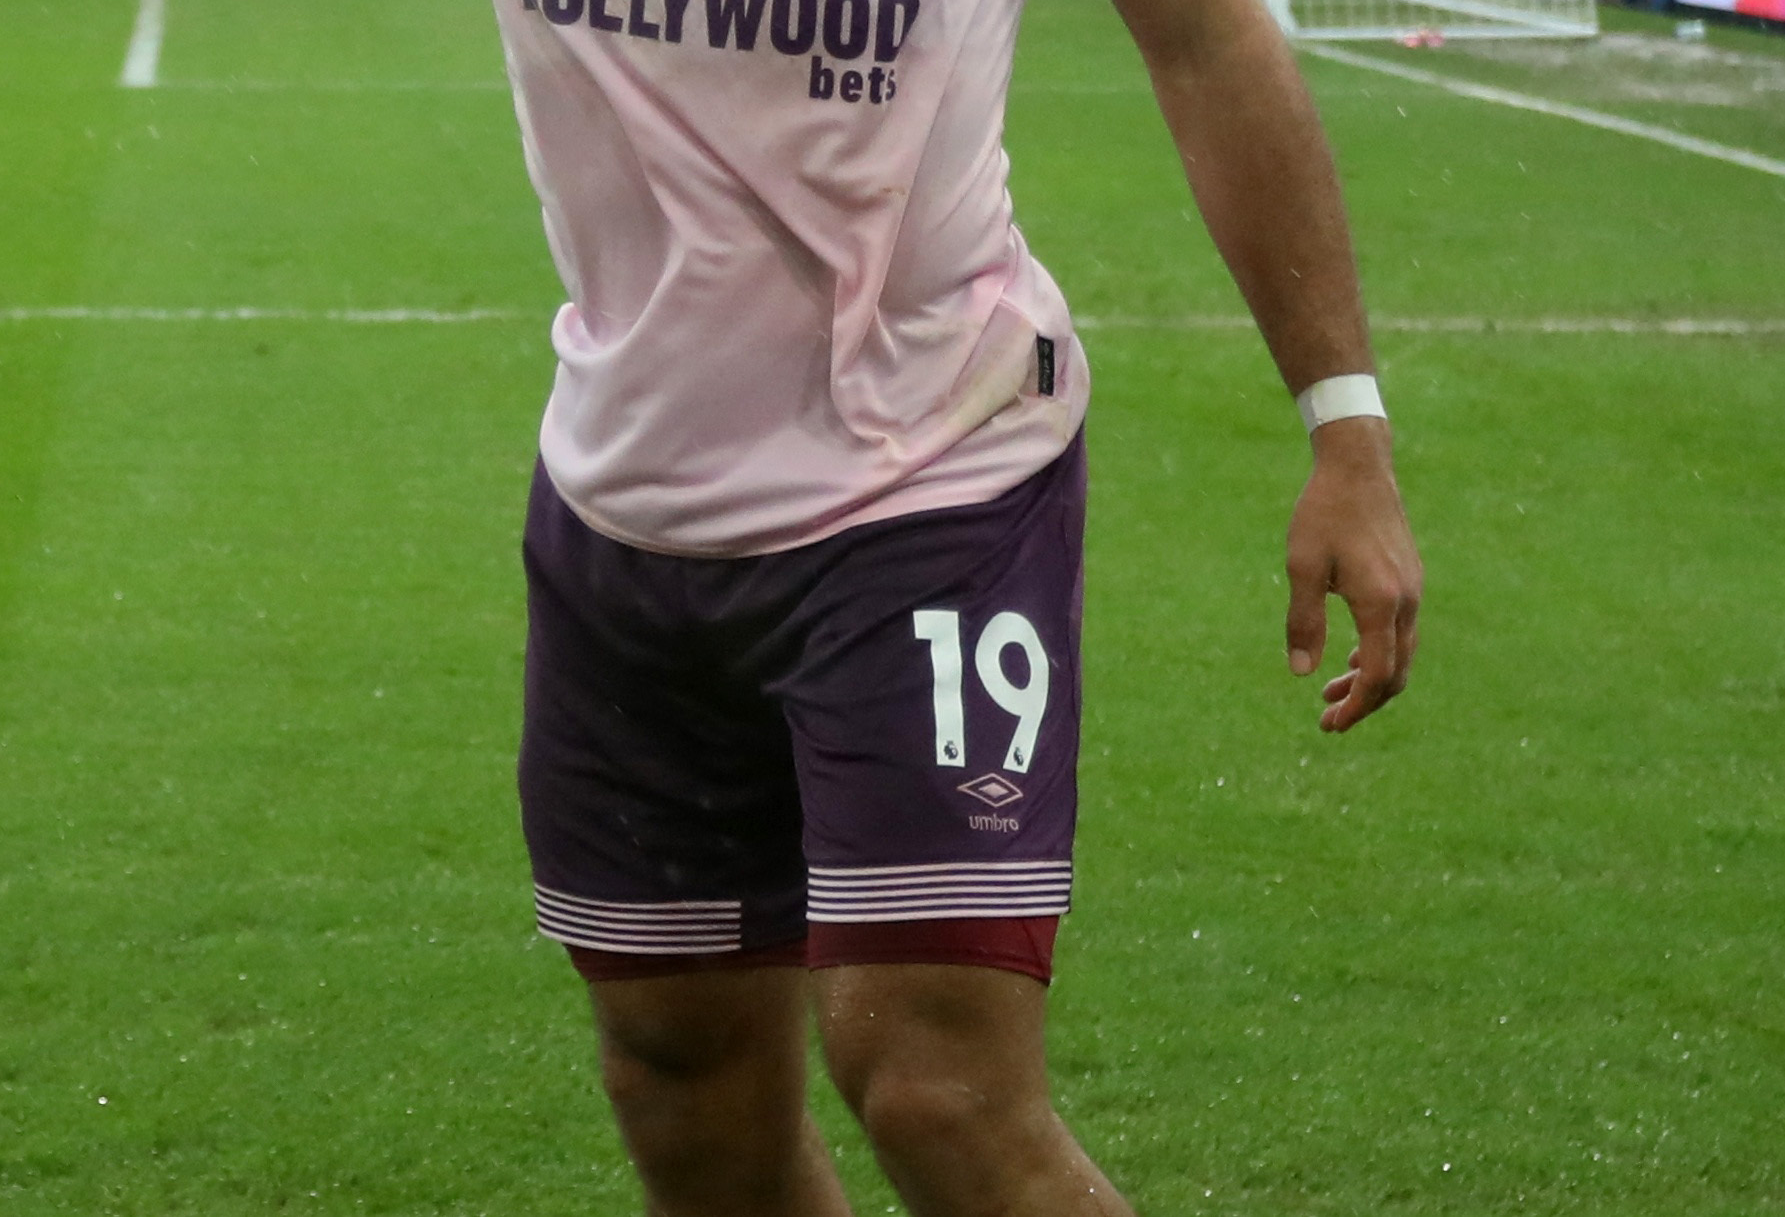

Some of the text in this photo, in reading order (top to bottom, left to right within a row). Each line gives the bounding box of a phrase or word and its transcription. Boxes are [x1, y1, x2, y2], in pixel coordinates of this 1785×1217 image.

[809, 55, 897, 105] bets
[913, 610, 1049, 774] 19
[968, 814, 1020, 833] umbro
